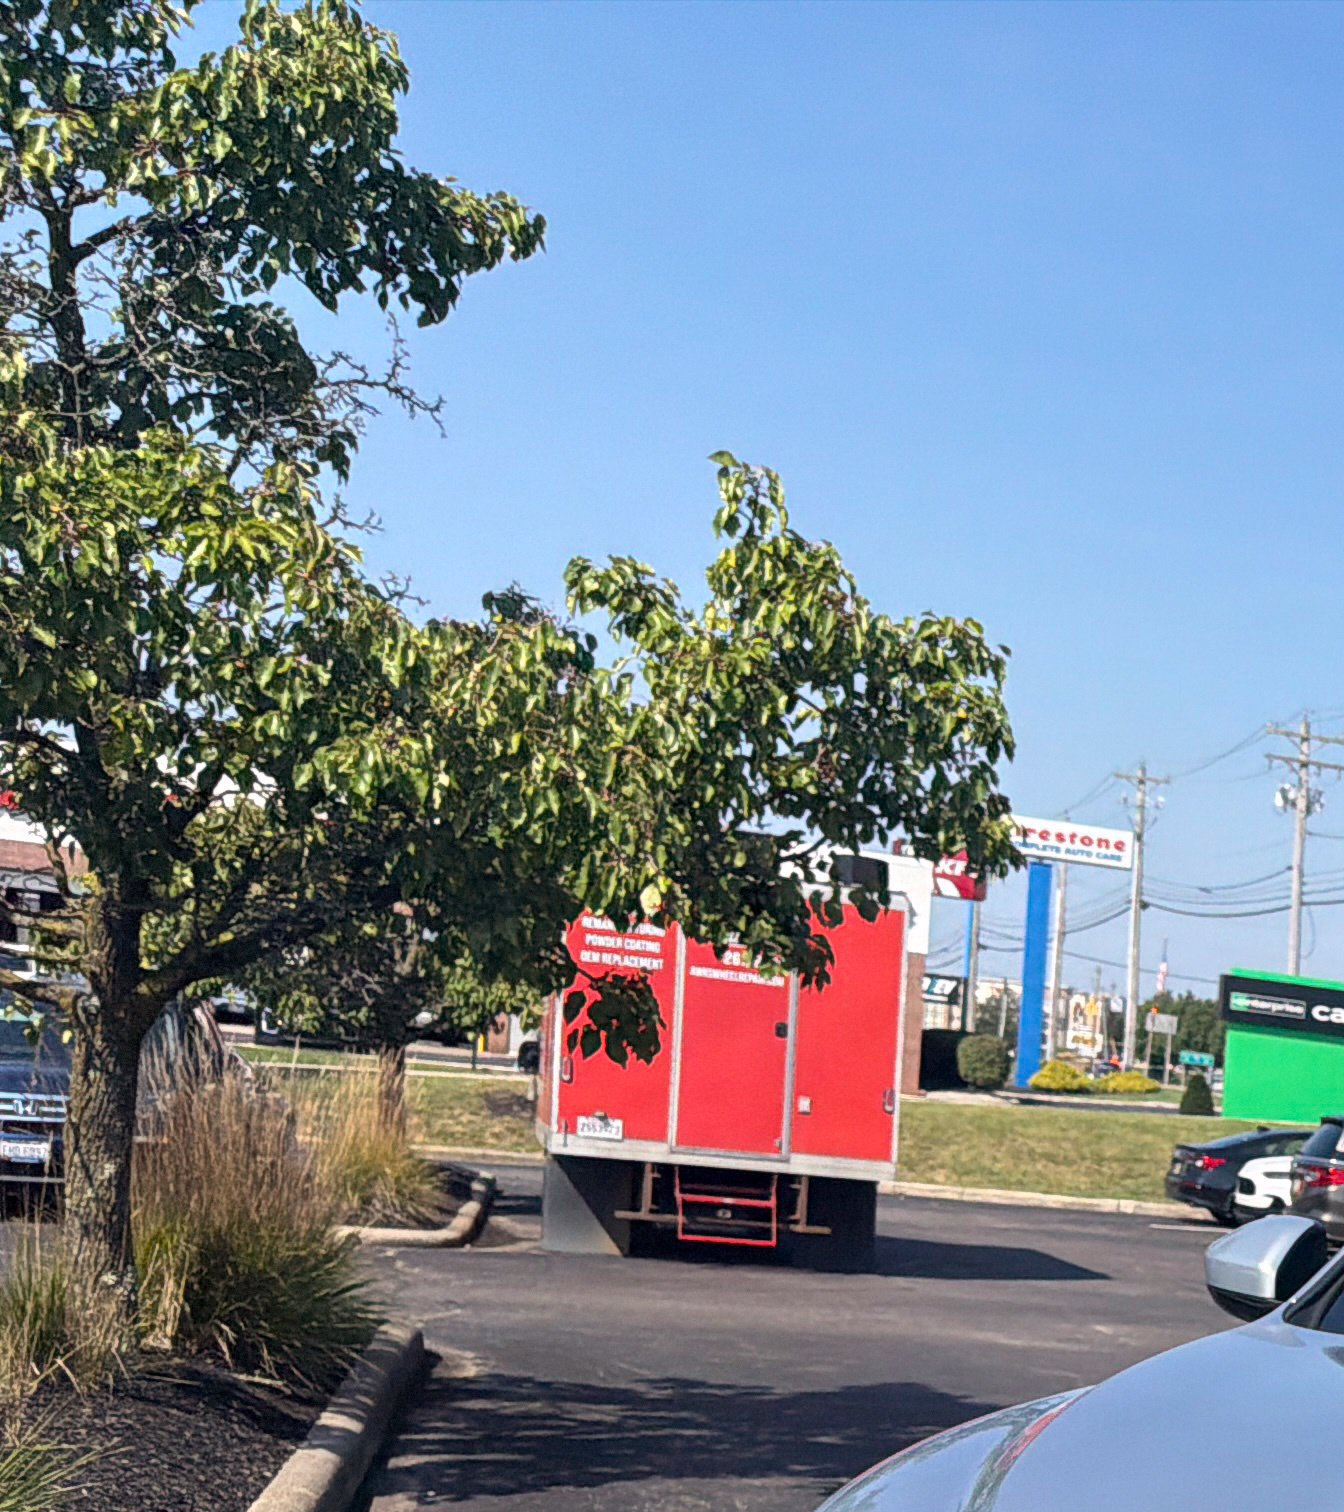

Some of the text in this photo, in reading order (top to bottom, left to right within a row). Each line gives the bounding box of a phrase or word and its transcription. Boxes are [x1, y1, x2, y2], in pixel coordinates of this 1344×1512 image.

[1065, 848, 1093, 859] AUTO
[585, 932, 661, 954] POWDER COATING
[580, 949, 664, 970] OEM REPLACEMENT
